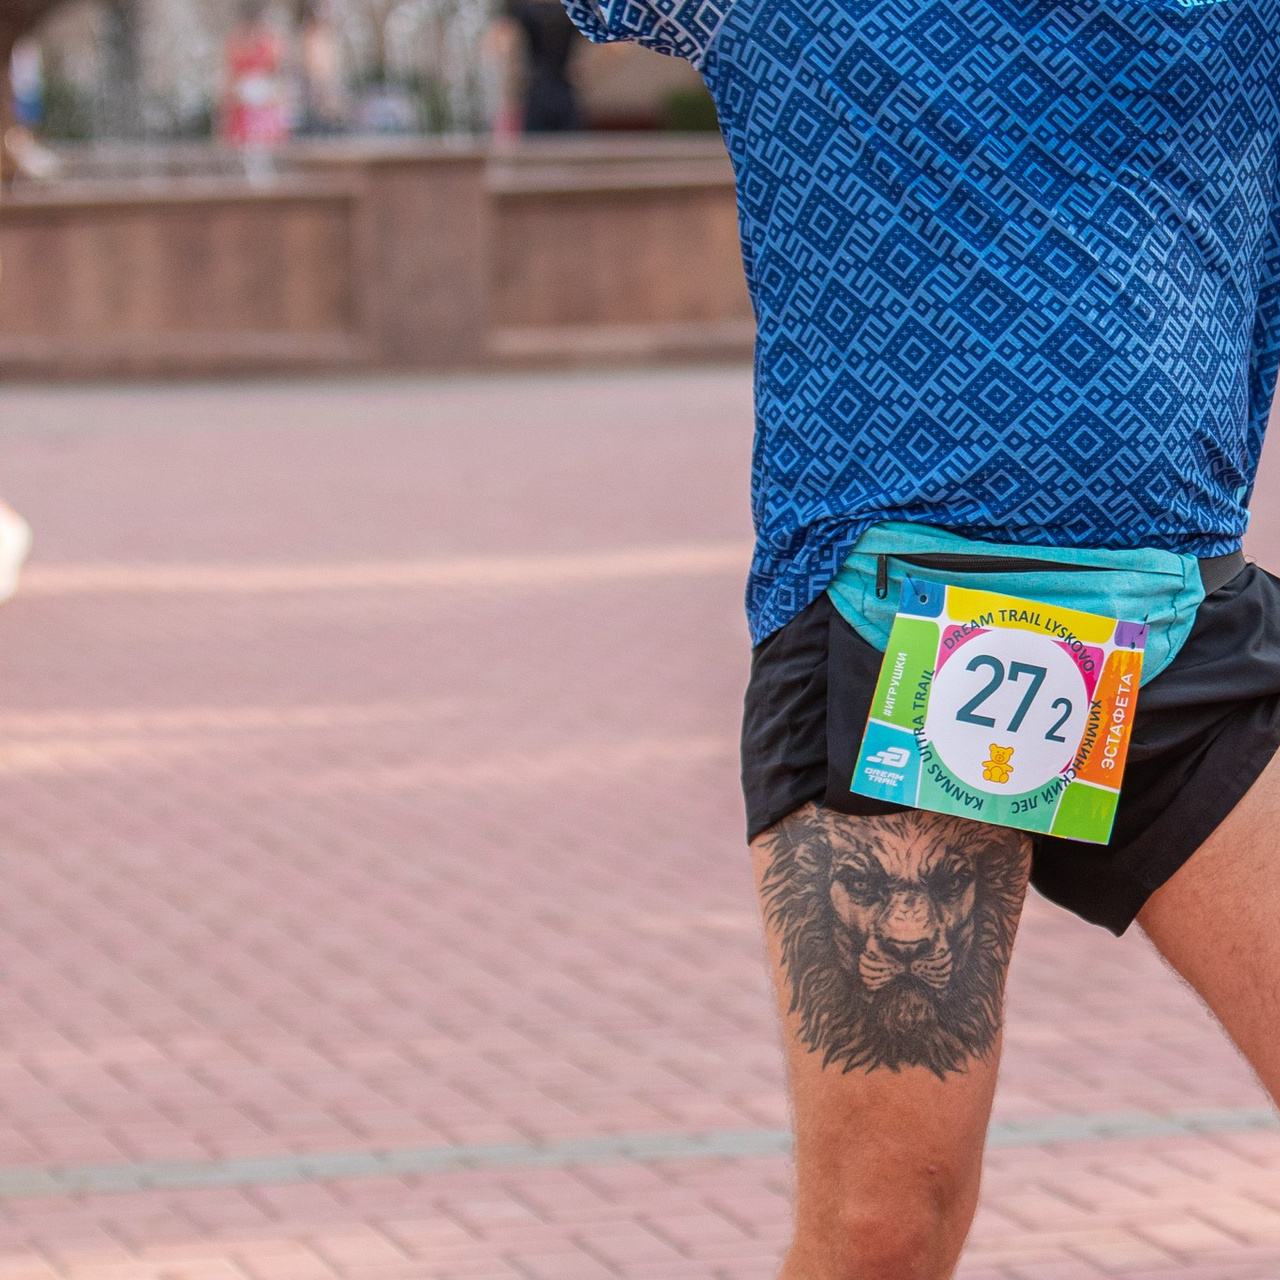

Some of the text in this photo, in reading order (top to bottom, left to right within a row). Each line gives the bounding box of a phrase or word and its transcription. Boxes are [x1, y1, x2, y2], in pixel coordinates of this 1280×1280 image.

[943, 609, 1095, 672] DREAM TRAIL LYSKOVO
[883, 652, 908, 717] #ИГРУШКИ
[912, 669, 936, 710] TRAIL
[1101, 673, 1134, 770] ЭСТАФЕТА
[864, 767, 905, 781] DREAM
[868, 775, 898, 787] TRAIL
[1011, 699, 1102, 814] ХИМКИНСКИЙ ЛЕС
[928, 762, 984, 811] KANNAS
